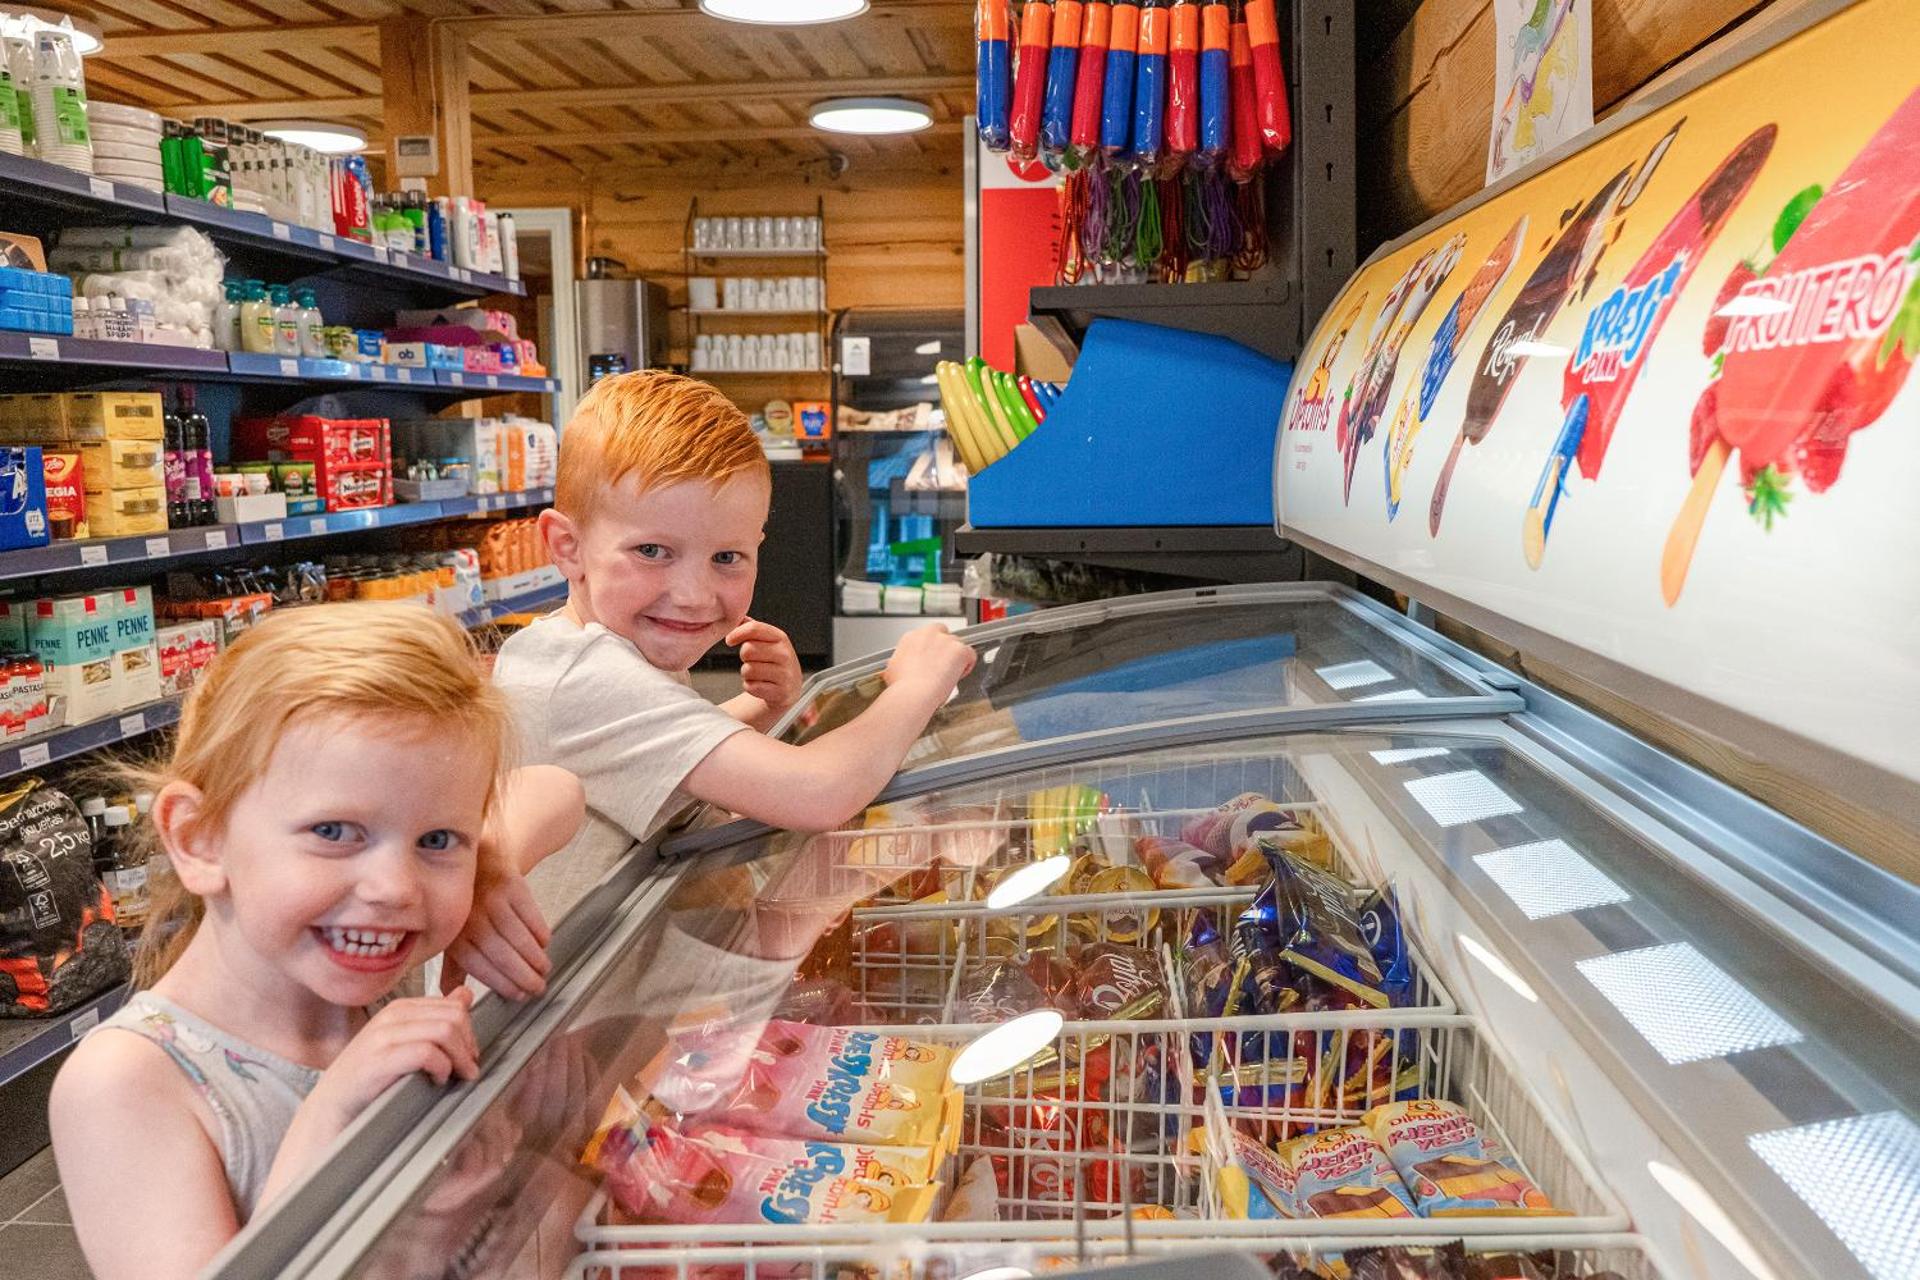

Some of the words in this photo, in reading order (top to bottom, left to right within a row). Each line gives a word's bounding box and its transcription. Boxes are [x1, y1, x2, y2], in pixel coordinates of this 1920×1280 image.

[46, 485, 78, 497] EGIA
[117, 615, 149, 638] PENNE
[35, 639, 62, 649] PENNE
[77, 625, 110, 649] PENNE
[12, 682, 43, 695] PASTAS
[40, 831, 76, 859] 2,5
